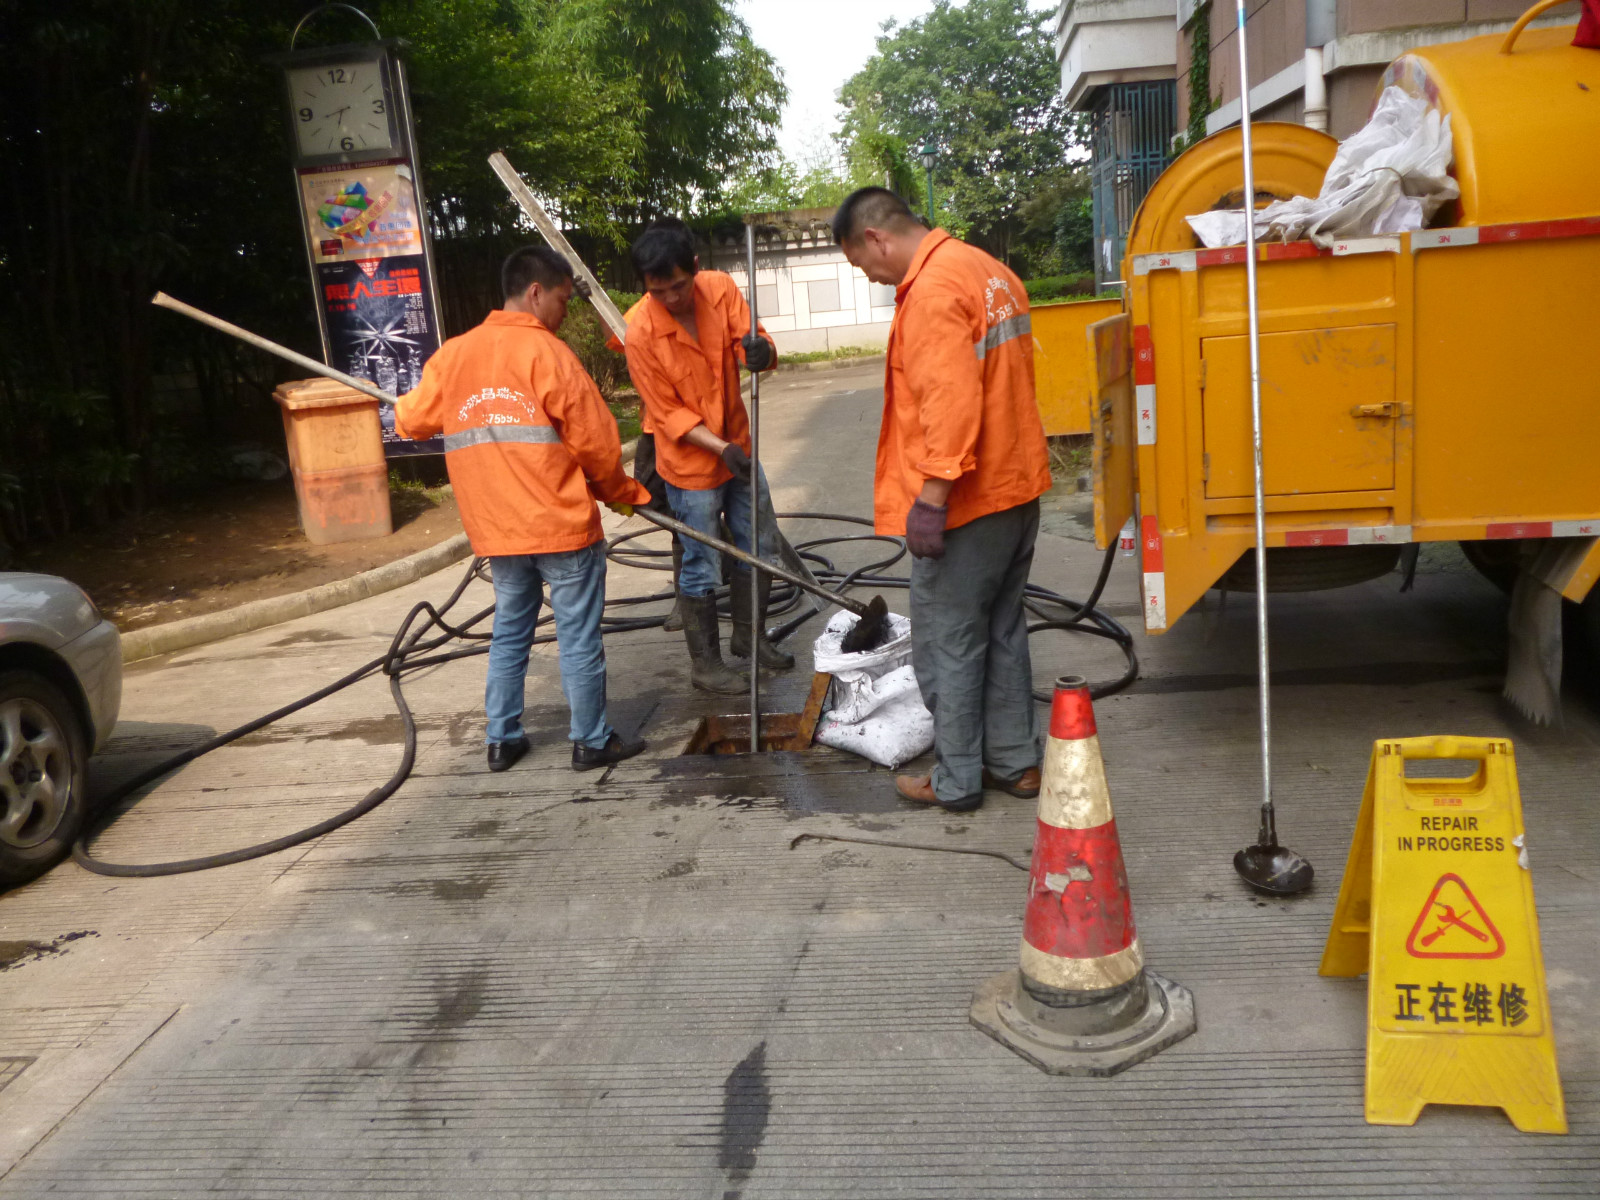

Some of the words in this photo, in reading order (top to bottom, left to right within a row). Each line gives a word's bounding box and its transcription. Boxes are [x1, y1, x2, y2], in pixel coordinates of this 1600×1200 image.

[328, 68, 346, 85] 12
[299, 107, 314, 122] 9
[372, 99, 385, 115] 3
[340, 136, 355, 152] 6
[1421, 816, 1479, 831] REPAIR
[1398, 837, 1413, 851] IN
[1417, 837, 1505, 852] PROGRESS
[1394, 981, 1530, 1028] 正在维修
